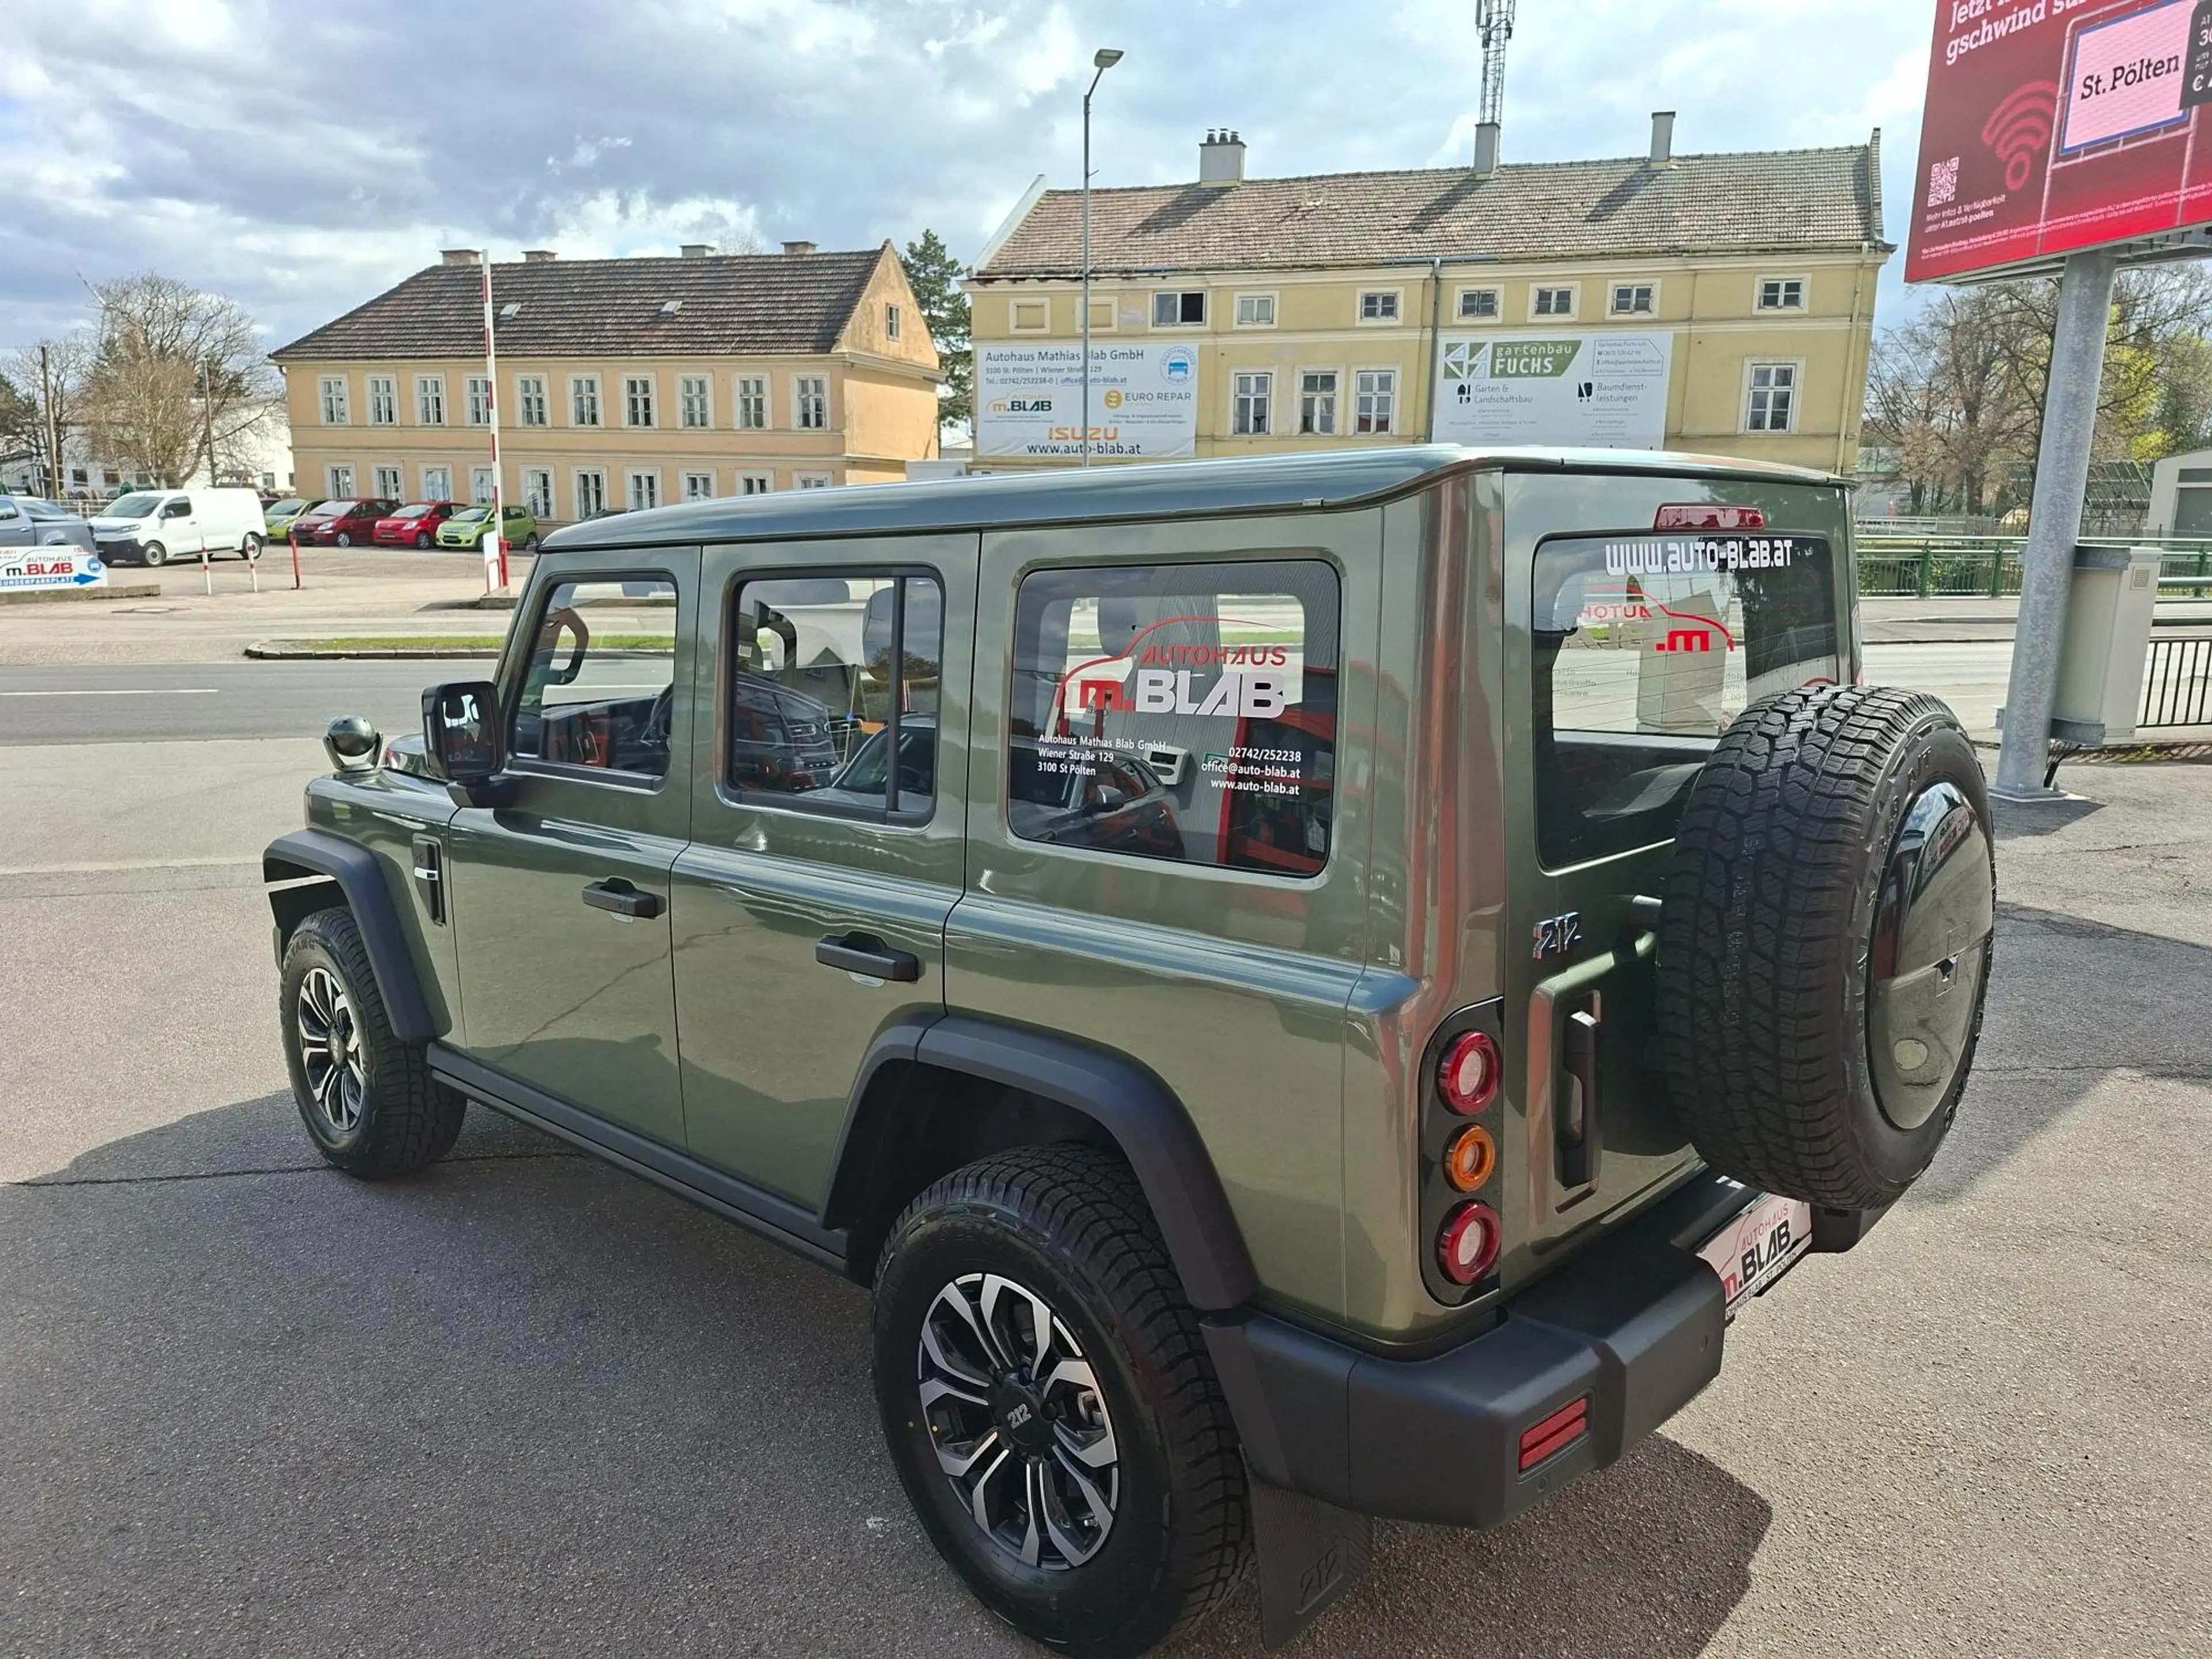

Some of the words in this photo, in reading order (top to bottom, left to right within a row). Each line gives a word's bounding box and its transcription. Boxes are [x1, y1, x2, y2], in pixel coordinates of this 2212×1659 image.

[1946, 0, 2046, 66] gschwind
[2080, 76, 2106, 100] St.
[2110, 55, 2180, 91] Pölten
[986, 351, 1035, 362] Autohaus
[1038, 350, 1080, 361] Mathias
[1084, 350, 1107, 360] lab
[1110, 350, 1143, 360] GmbH
[1496, 343, 1571, 357] gartenbau
[1495, 357, 1554, 374] FUCHS
[1475, 384, 1501, 392] Garten
[1125, 393, 1154, 402] EURO
[1157, 392, 1191, 402] REPAR
[1475, 395, 1533, 403] Landschaftsbau
[1597, 394, 1638, 403] leistungen
[993, 401, 1052, 412] m.BLAB
[1048, 427, 1118, 441] ISUZU
[6, 563, 73, 575] m.BLAB
[1141, 645, 1287, 666] AUTOHAUS
[1039, 734, 1076, 745] Autohaus
[1080, 736, 1112, 748] Mathias
[1116, 738, 1134, 749] Blab
[1138, 740, 1166, 751] GmbH
[1038, 748, 1066, 759] Wiener
[1069, 750, 1095, 761] Straße
[1099, 752, 1114, 762] 129
[1229, 747, 1301, 762] 02742/252238
[1037, 762, 1057, 773] 3100
[1070, 765, 1096, 776] Pölten
[1201, 760, 1301, 779] office@auto-blab.at
[1211, 779, 1300, 795] www.auto-blab.at
[1533, 912, 1581, 960] 212
[1741, 1203, 1788, 1251] AUTOHAUS
[1007, 1404, 1031, 1429] 212
